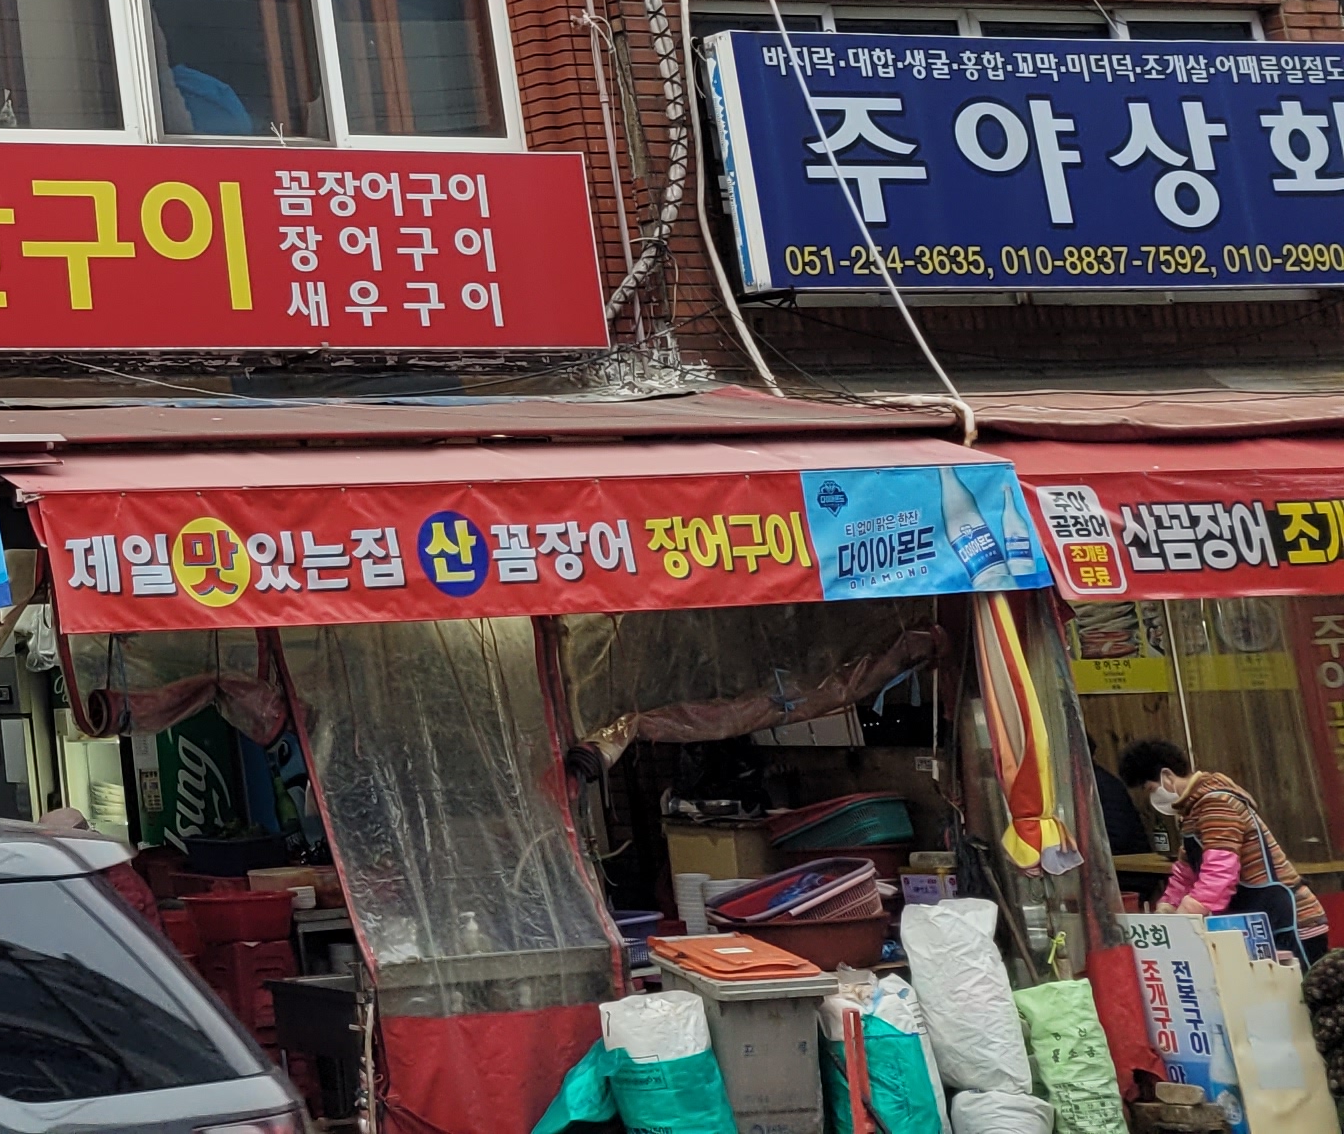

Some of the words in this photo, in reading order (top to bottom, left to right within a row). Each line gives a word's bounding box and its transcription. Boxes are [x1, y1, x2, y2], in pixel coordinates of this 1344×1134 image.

[805, 95, 1344, 228] 주야상회
[273, 169, 491, 219] 꼼장어구이
[279, 225, 497, 275] 장어구이
[784, 245, 994, 282] 051-254-3635,
[1001, 244, 1218, 278] 010-8837-7592,
[286, 280, 506, 329] 새우구이
[1048, 490, 1091, 514] 주야
[1049, 514, 1111, 539] 곰장어
[645, 511, 813, 578] 장어구이
[838, 529, 937, 578] 다이아몬드
[1069, 544, 1109, 564] 조개탕
[1120, 501, 1279, 572] 산꼼장어
[850, 565, 929, 591] DIAMOND
[1079, 566, 1113, 587] 무료
[1140, 960, 1180, 1055] 조개구이
[1171, 960, 1212, 1056] 전복구이
